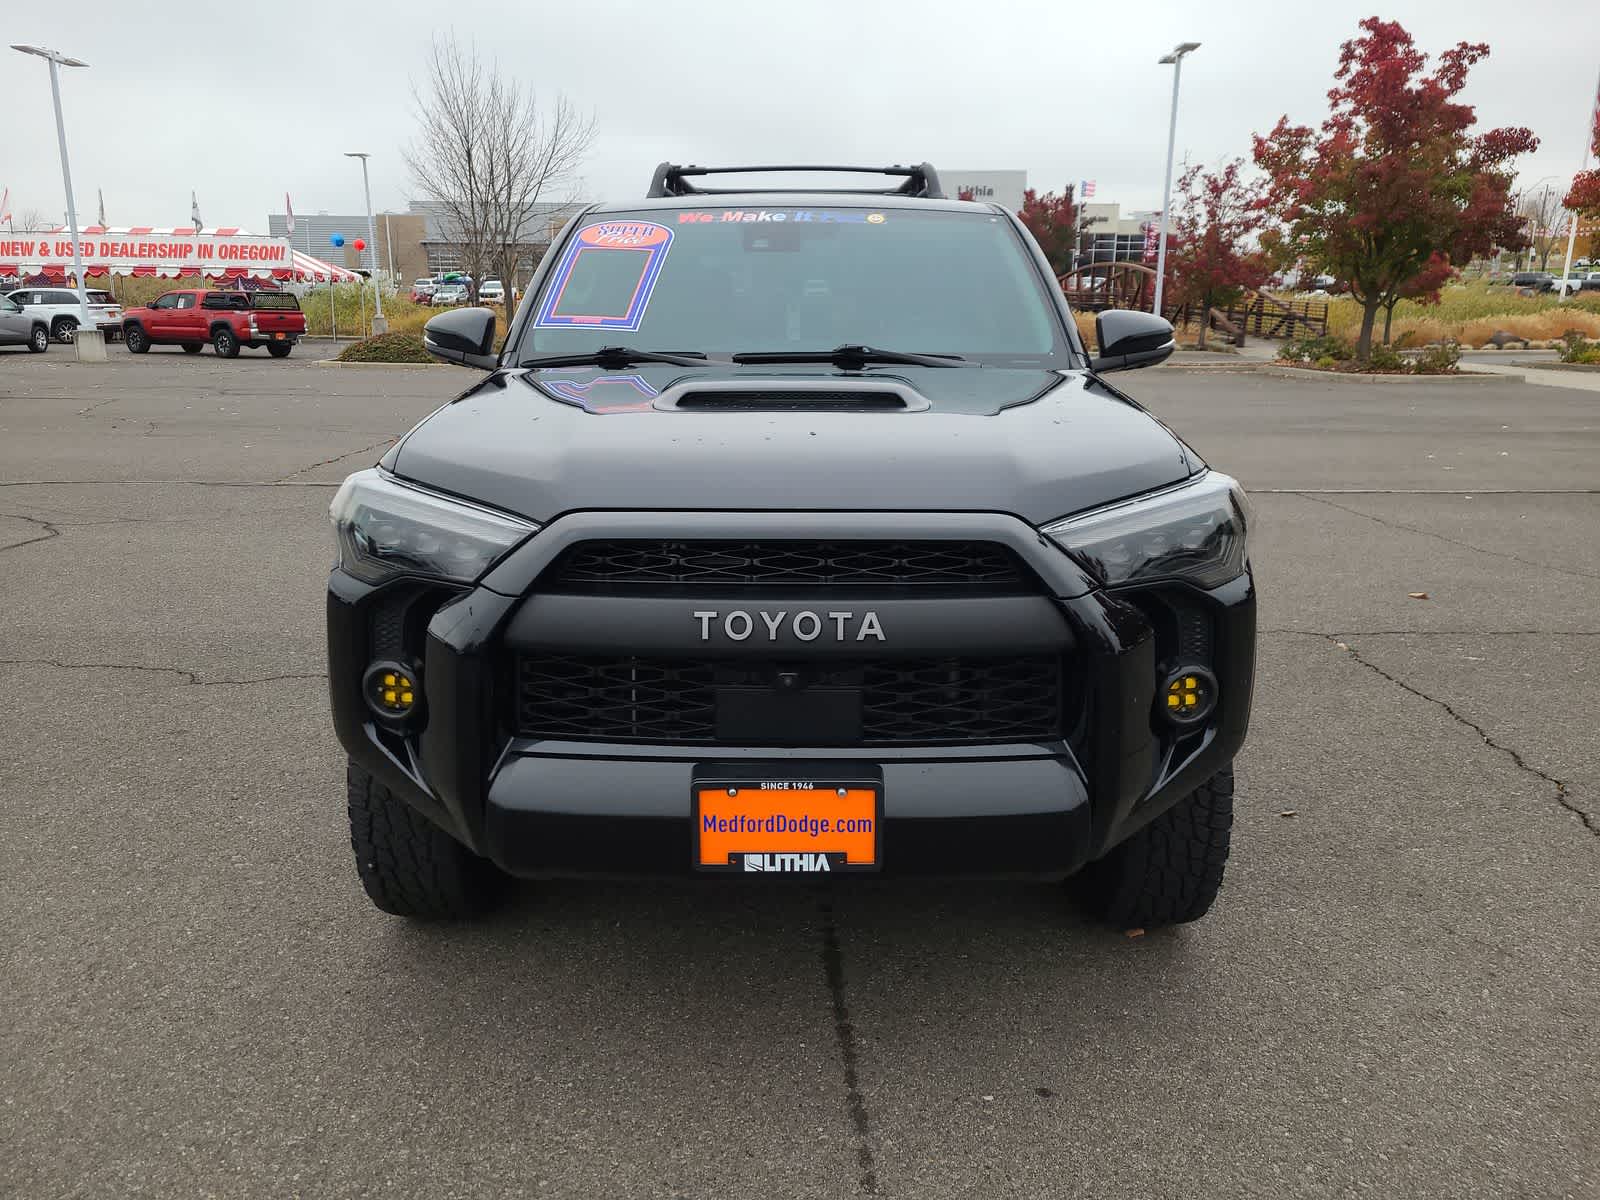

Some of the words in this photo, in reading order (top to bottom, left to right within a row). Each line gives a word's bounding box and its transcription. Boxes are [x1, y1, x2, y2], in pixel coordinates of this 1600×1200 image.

[678, 213, 714, 224] We
[720, 211, 786, 223] Make
[0, 241, 35, 257] NEW
[39, 241, 50, 257] &
[55, 242, 95, 257] USED
[100, 242, 193, 259] DEALERSHIP
[197, 244, 214, 259] IN
[218, 245, 286, 261] OREGON!
[693, 610, 887, 642] TOYOTA
[760, 782, 789, 790] SINCE
[792, 782, 814, 790] 1946
[703, 814, 873, 837] MedfordDodge.com
[764, 853, 830, 872] LITHIA
